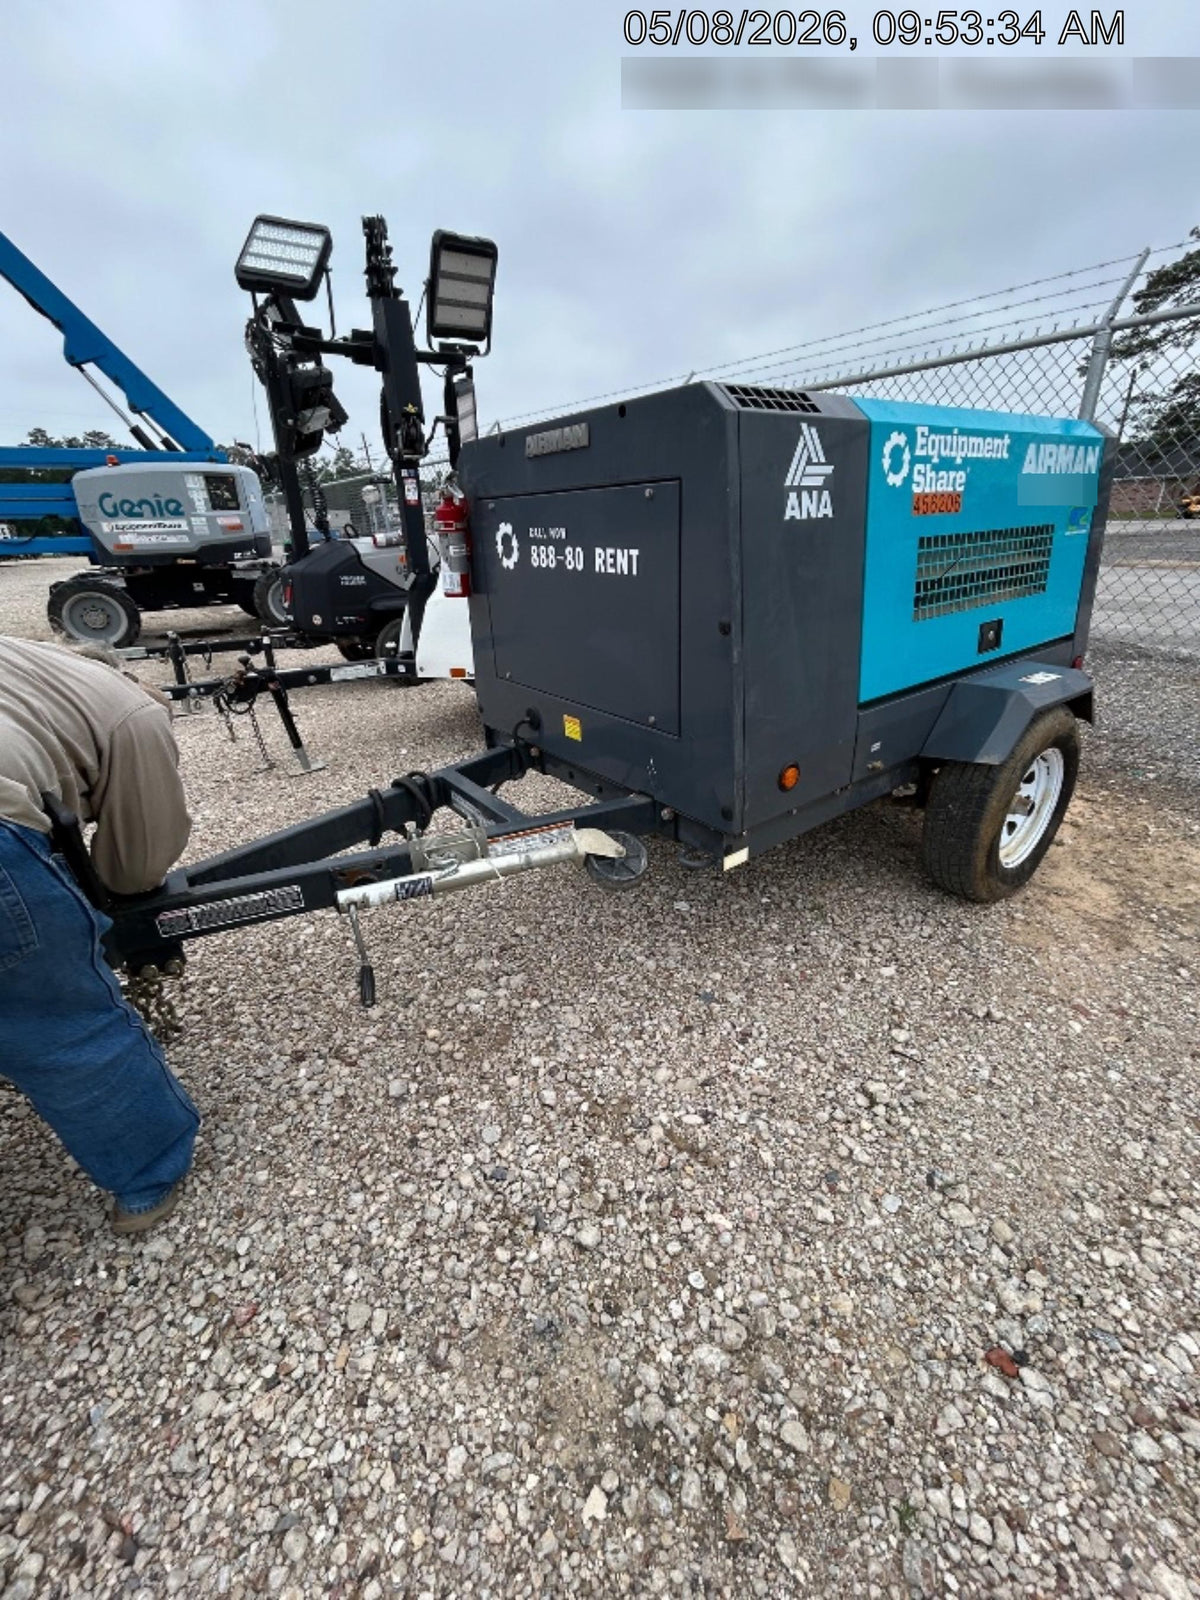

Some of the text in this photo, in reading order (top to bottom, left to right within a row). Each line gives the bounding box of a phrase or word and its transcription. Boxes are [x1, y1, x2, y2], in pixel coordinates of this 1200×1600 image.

[914, 426, 1011, 465] Equipment
[1022, 443, 1100, 474] AIRMAN
[912, 464, 966, 493] Share
[98, 492, 186, 518] Genie
[784, 490, 834, 520] ANA
[531, 545, 639, 576] 888-80 RENT
